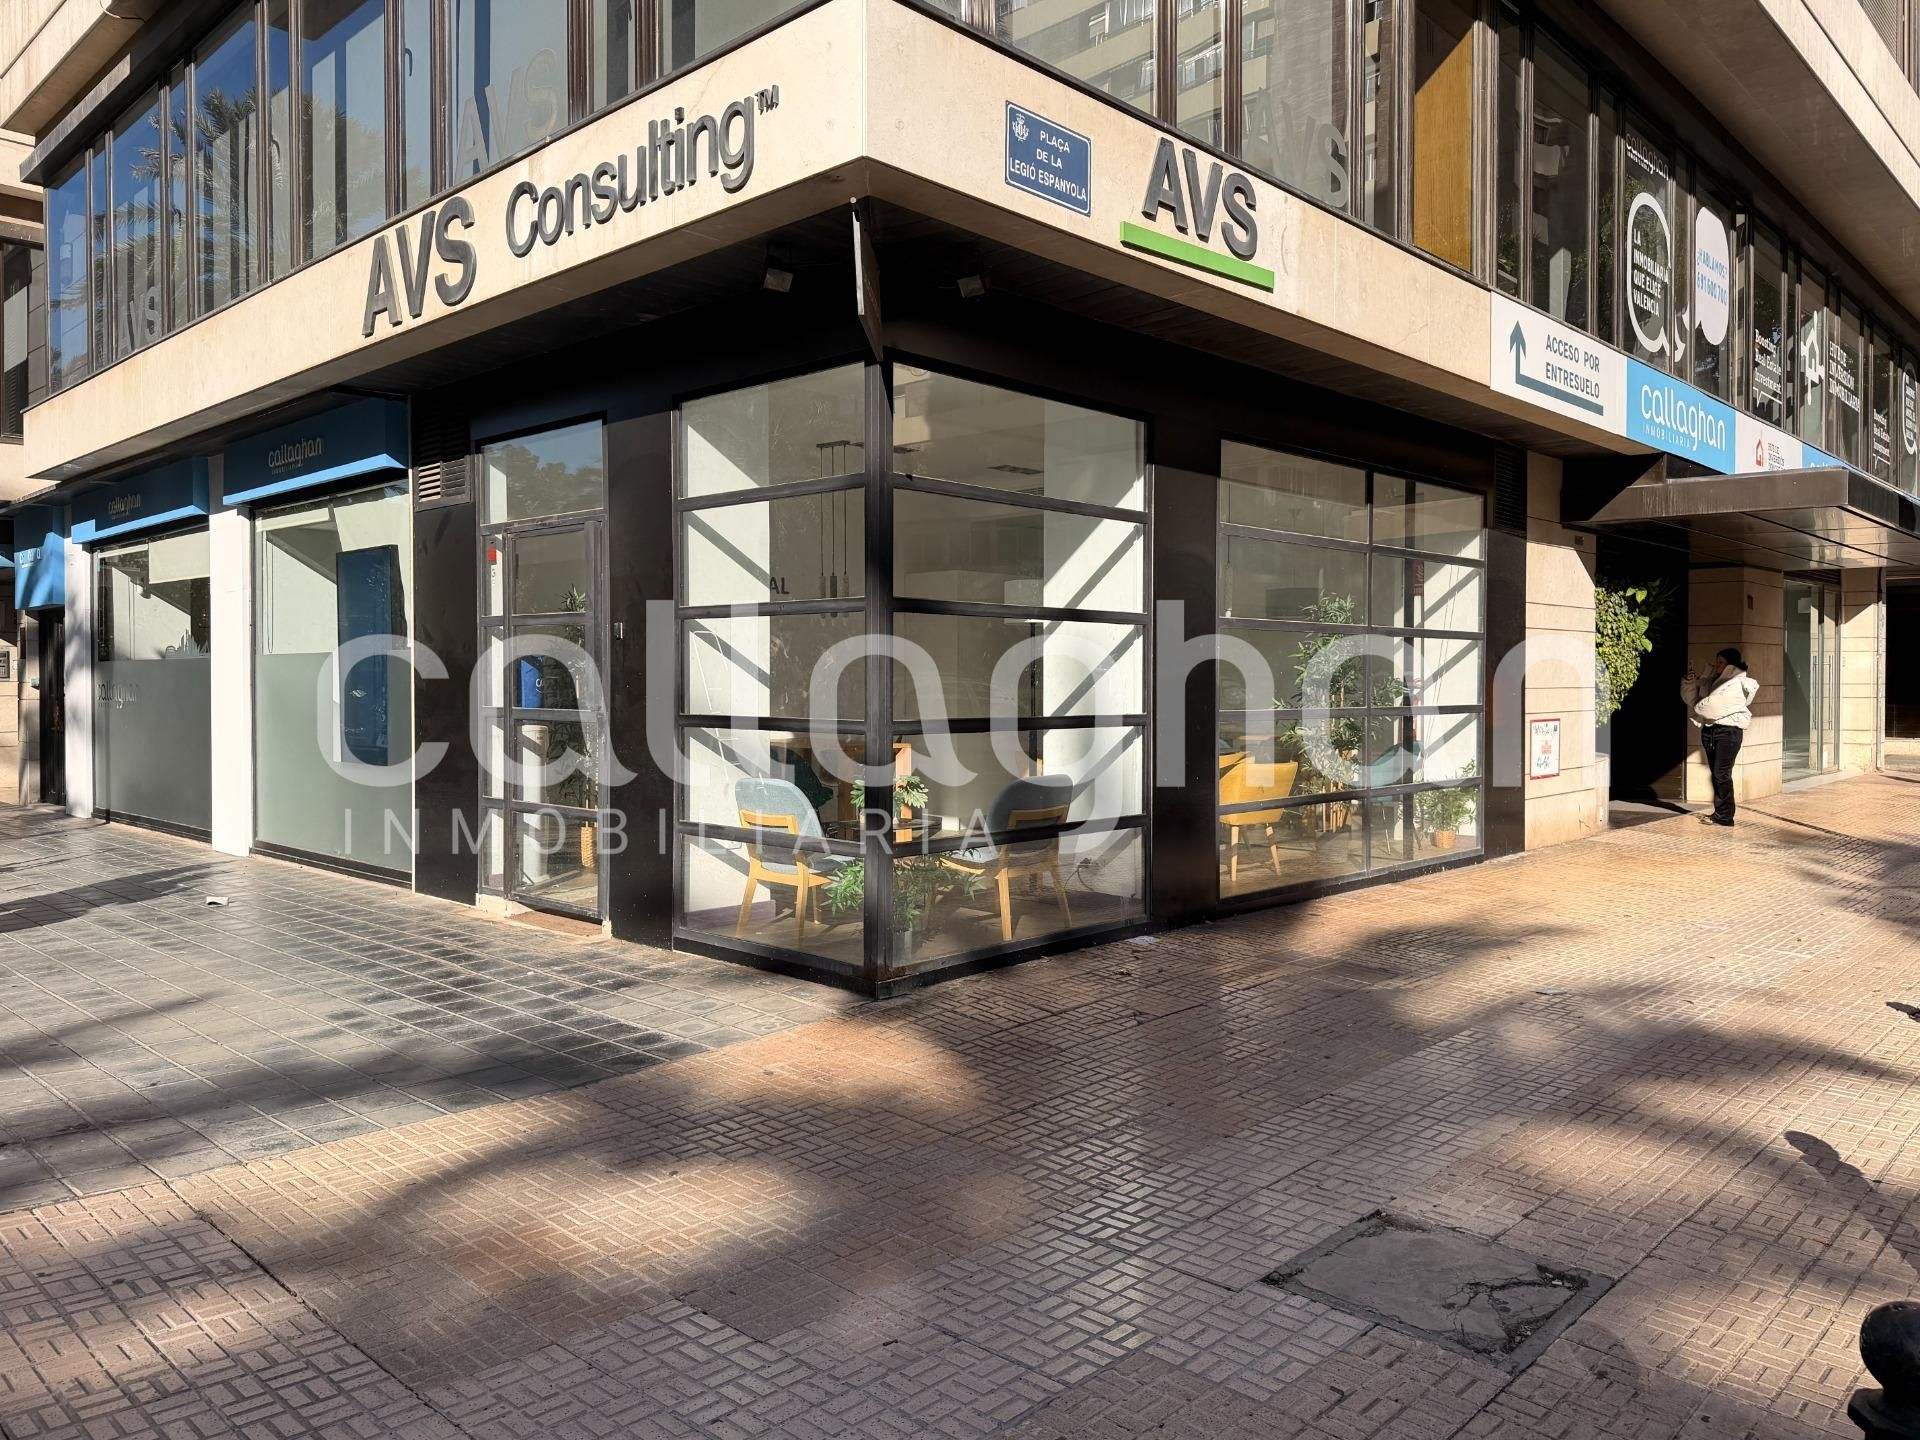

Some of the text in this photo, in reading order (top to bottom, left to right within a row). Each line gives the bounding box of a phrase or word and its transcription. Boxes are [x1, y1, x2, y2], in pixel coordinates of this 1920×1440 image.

[1036, 148, 1062, 169] DE LA
[1040, 130, 1070, 153] PLAÇA
[1010, 157, 1087, 202] LEGIÓ ESPANYOLA
[1141, 136, 1258, 261] AVS
[361, 196, 478, 338] AVS
[505, 96, 755, 260] Consulting
[1633, 228, 1641, 246] LA
[1633, 248, 1669, 285] INMOBILIARIA
[1633, 269, 1645, 289] QUE
[1633, 288, 1659, 317] VALENCIA
[1545, 334, 1600, 373] ACCESO POR
[1545, 362, 1600, 399] ENTRESUELO
[1641, 384, 1726, 452] callaghan
[268, 437, 323, 468] callaghan
[1643, 423, 1691, 449] INMOBILIARIA
